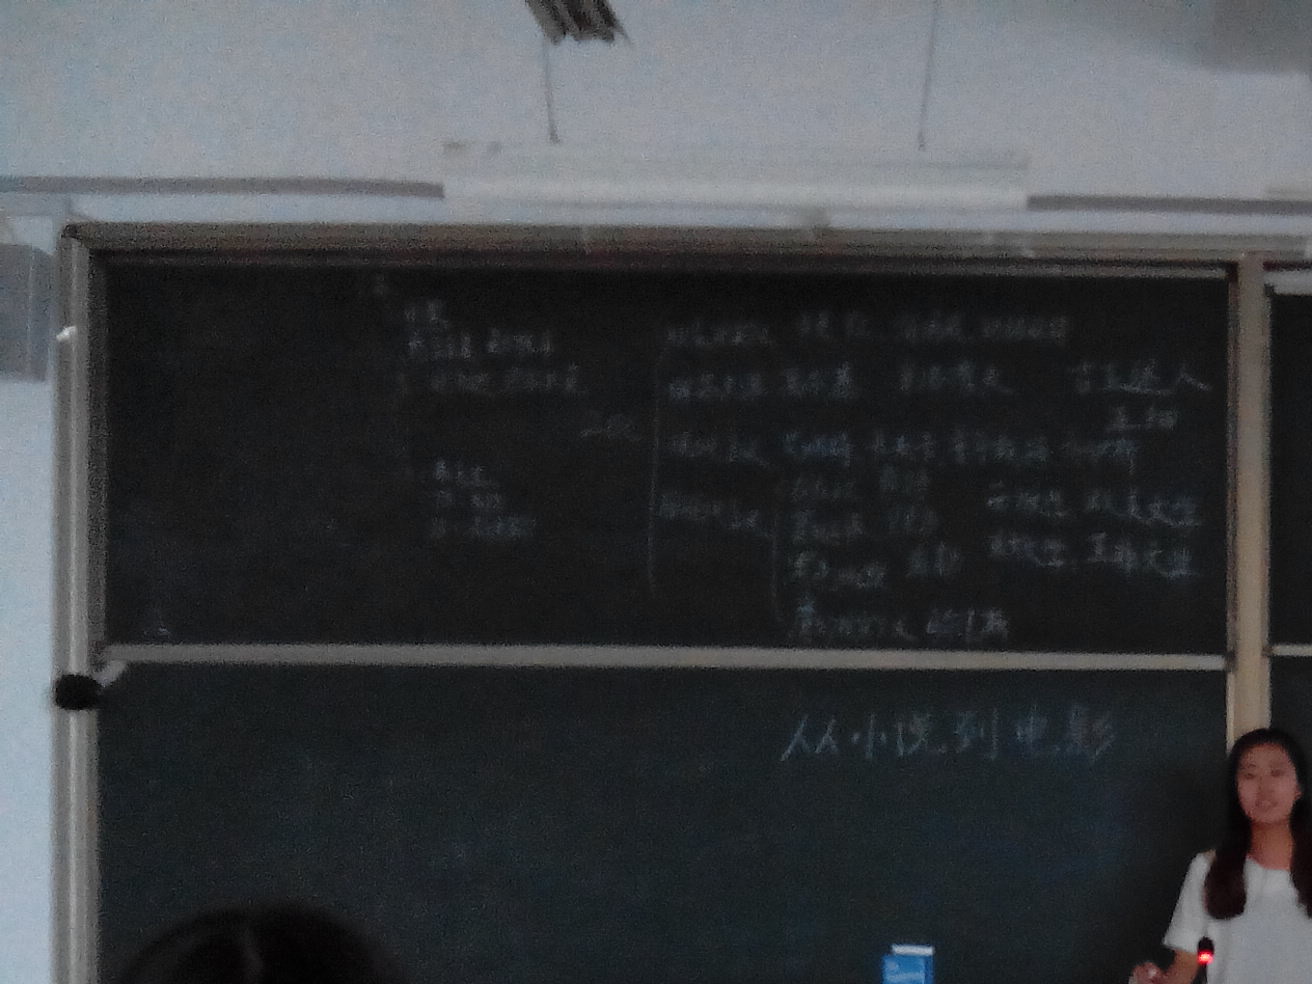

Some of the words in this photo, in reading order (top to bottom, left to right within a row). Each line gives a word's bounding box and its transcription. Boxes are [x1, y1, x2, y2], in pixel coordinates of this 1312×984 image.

[780, 702, 1117, 766] 从小说到电影
